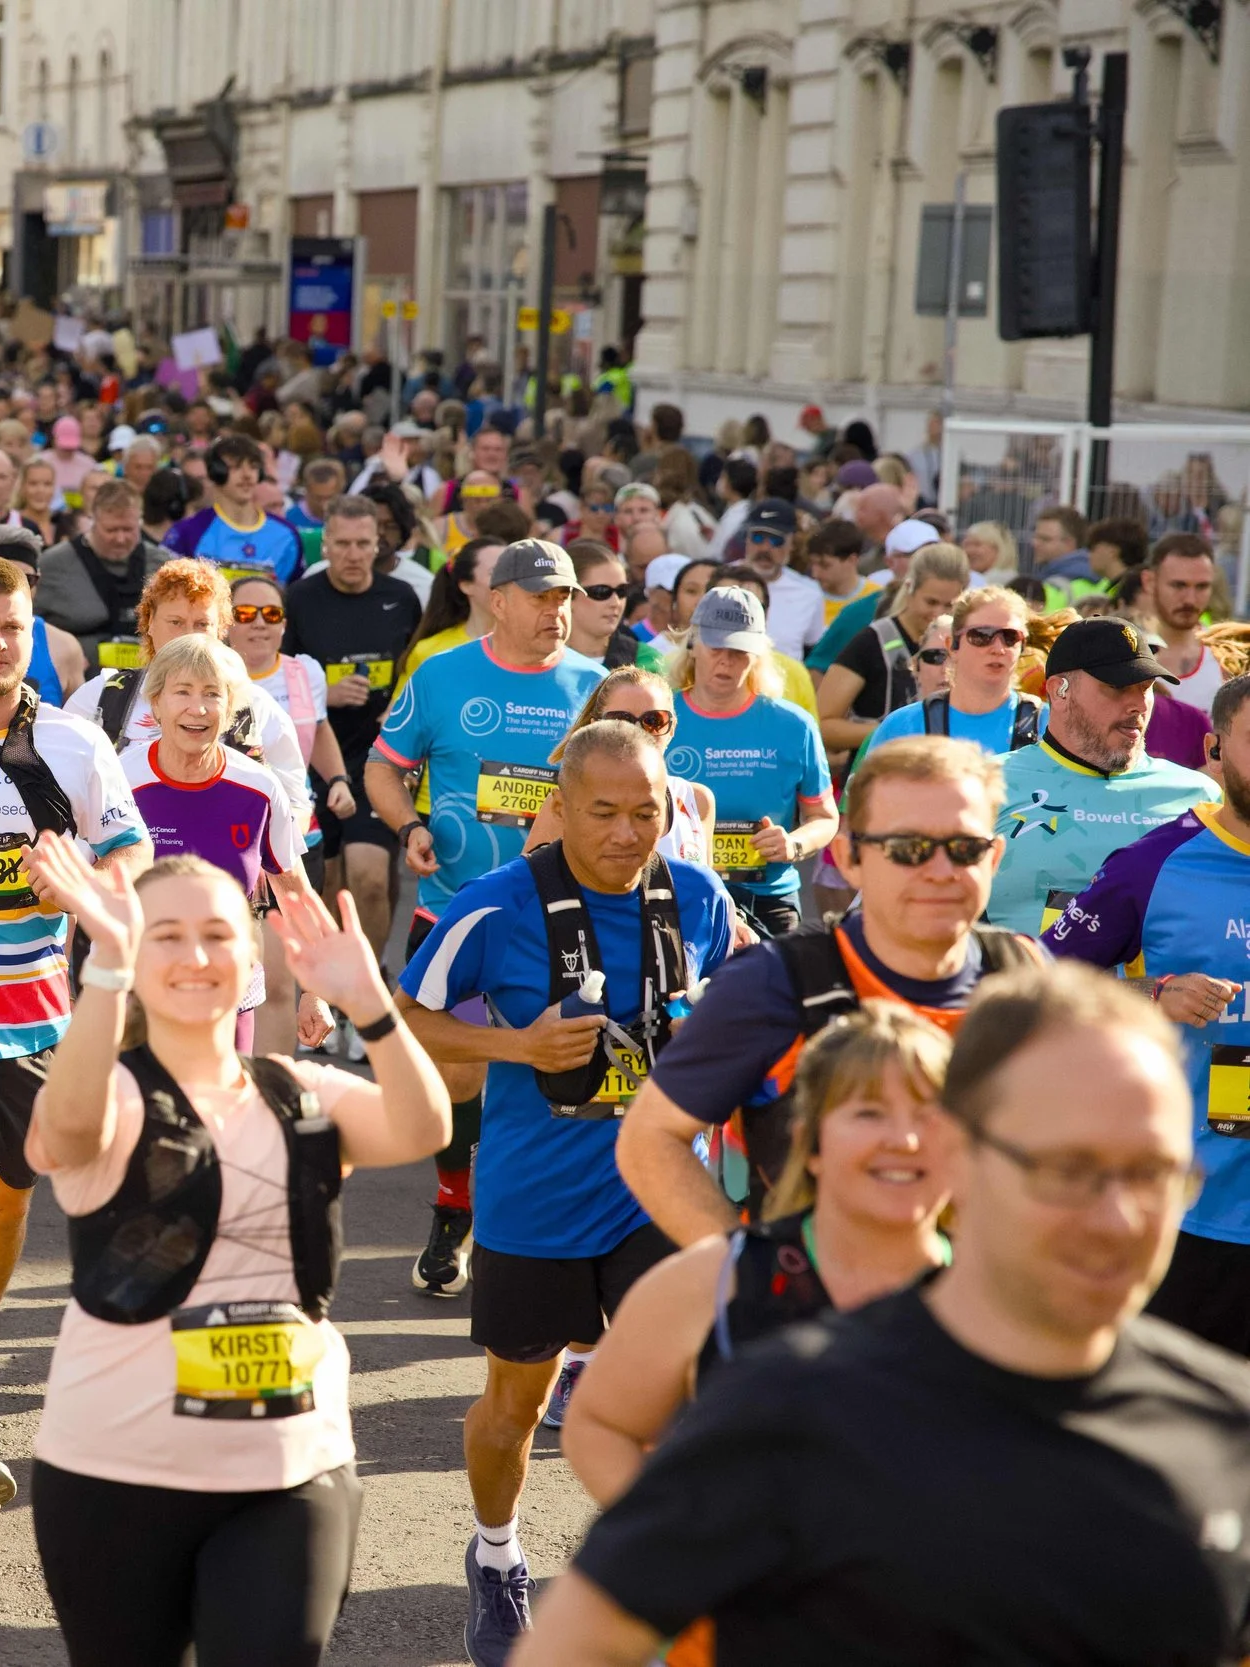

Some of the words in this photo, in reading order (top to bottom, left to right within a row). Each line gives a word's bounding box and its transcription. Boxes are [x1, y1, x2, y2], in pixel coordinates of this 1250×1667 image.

[505, 701, 578, 720] SarcomaU
[505, 716, 520, 725] The
[521, 717, 541, 726] bone
[542, 719, 548, 727] &
[550, 720, 565, 728] soft
[505, 726, 530, 734] cancer
[532, 727, 559, 737] charity
[705, 747, 777, 759] SarcomaUK
[706, 761, 719, 769] The
[720, 761, 738, 769] bone
[512, 766, 538, 776] CARDIFF
[538, 769, 555, 778] HALF
[1073, 809, 1128, 825] Bowel
[156, 826, 177, 834] Cancer
[161, 838, 184, 847] Training
[714, 837, 745, 850] OAN
[712, 851, 748, 865] 6362
[221, 1360, 293, 1385] 10771
